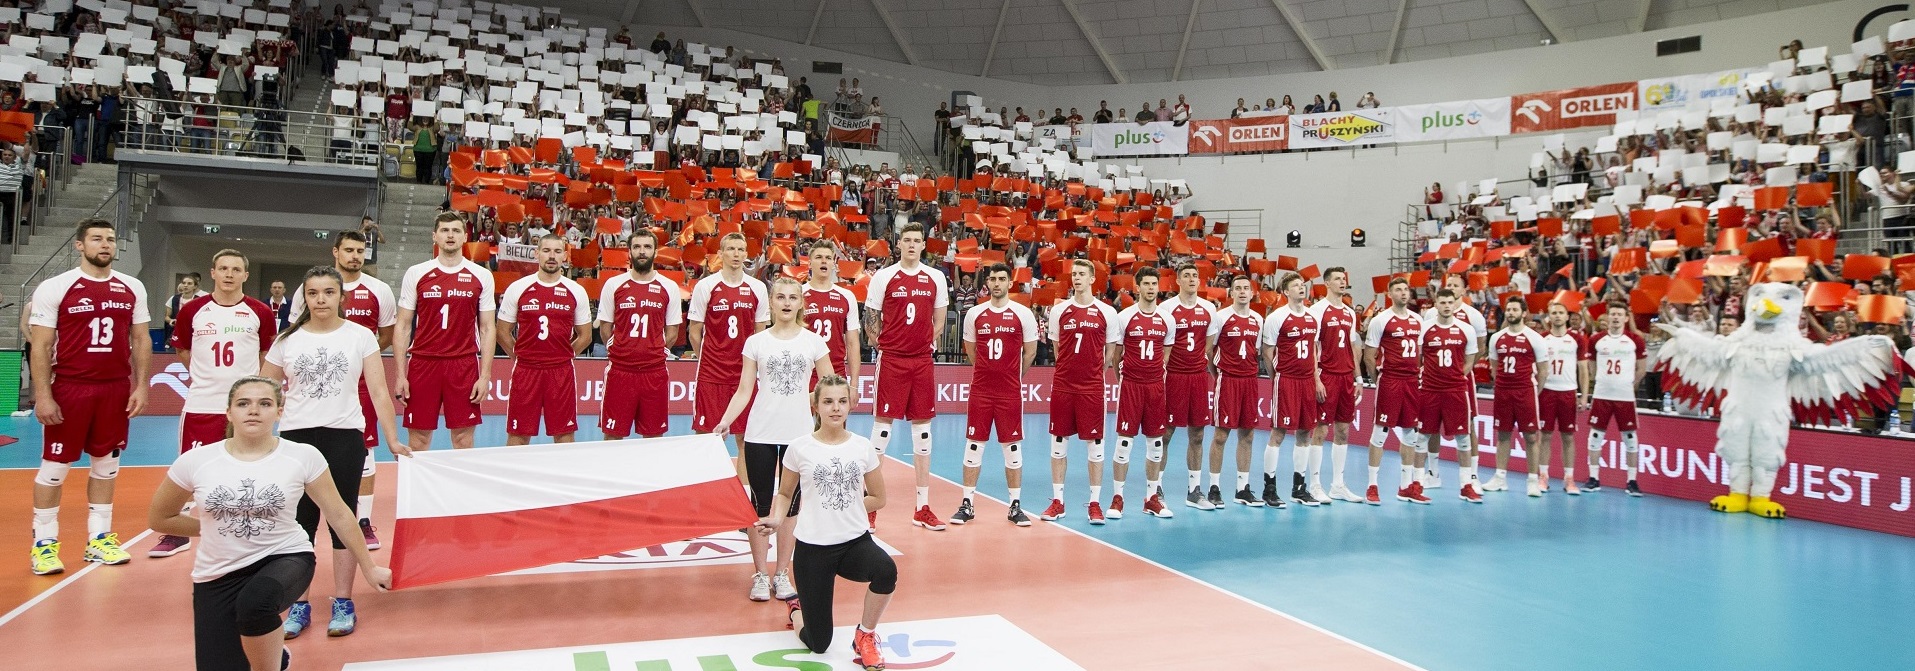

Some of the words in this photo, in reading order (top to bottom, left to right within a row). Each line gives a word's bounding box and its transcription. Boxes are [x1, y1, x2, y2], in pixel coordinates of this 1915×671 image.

[1565, 96, 1628, 114] ORLEN
[1303, 116, 1356, 127] BLACHY
[1422, 111, 1465, 133] plus
[1114, 129, 1151, 149] plus
[1232, 126, 1281, 140] ORLEN
[1303, 124, 1384, 140] PRUSZYŃSKI
[447, 289, 466, 298] plus
[911, 289, 927, 297] plus
[102, 300, 124, 310] plus
[545, 301, 563, 310] plus
[640, 299, 657, 308] plus
[733, 301, 748, 309] plus
[823, 305, 838, 313] plus
[345, 307, 364, 317] plus
[440, 303, 450, 330] 1
[906, 302, 916, 325] 9
[88, 317, 114, 345] 13
[224, 325, 246, 334] plus
[537, 315, 549, 340] 3
[629, 313, 649, 338] 21
[727, 315, 738, 339] 8
[814, 319, 832, 342] 23
[995, 325, 1010, 334] plus
[1080, 320, 1094, 328] plus
[1191, 320, 1204, 328] plus
[1147, 329, 1162, 337] plus
[1338, 329, 1346, 348] 2
[986, 338, 1003, 360] 19
[1075, 333, 1083, 354] 7
[1186, 332, 1195, 352] 5
[1401, 339, 1416, 358] 22
[211, 341, 234, 367] 16
[1139, 340, 1154, 360] 14
[1239, 340, 1247, 360] 4
[1295, 340, 1309, 360] 15
[1436, 348, 1453, 367] 18
[1502, 355, 1516, 374] 12
[1551, 359, 1564, 375] 17
[1606, 359, 1621, 375] 26
[883, 403, 890, 413] 9
[408, 413, 413, 424] 1
[512, 419, 518, 430] 3
[606, 418, 616, 430] 21
[699, 416, 706, 426] 8
[1168, 414, 1174, 423] 5
[1283, 416, 1291, 425] 15
[1380, 413, 1388, 423] 22
[1121, 421, 1129, 431] 14
[51, 442, 63, 455] 13
[1780, 463, 1879, 507] JEST
